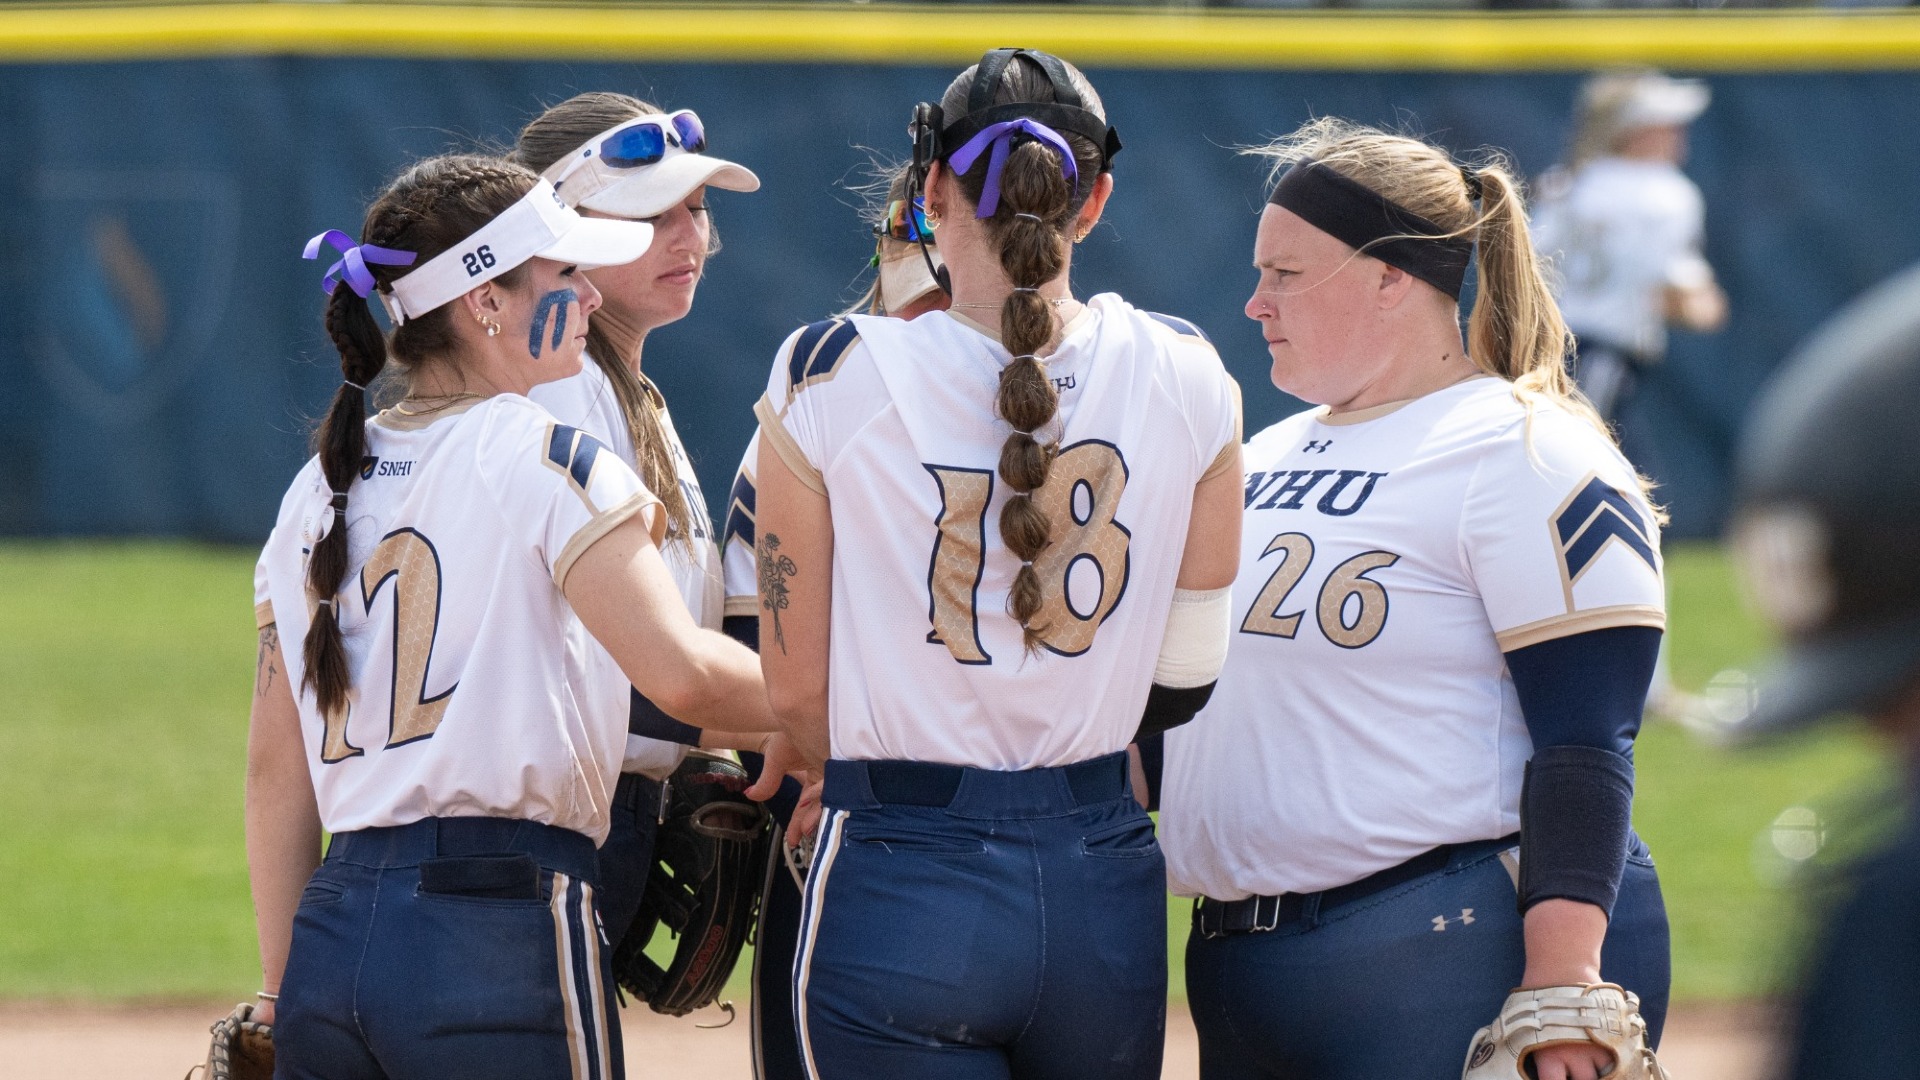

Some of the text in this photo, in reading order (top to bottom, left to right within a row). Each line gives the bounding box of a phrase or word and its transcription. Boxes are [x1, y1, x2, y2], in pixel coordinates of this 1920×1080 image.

[461, 244, 496, 277] 26
[1244, 470, 1389, 516] NHU
[921, 438, 1131, 665] 18
[1239, 532, 1402, 649] 26
